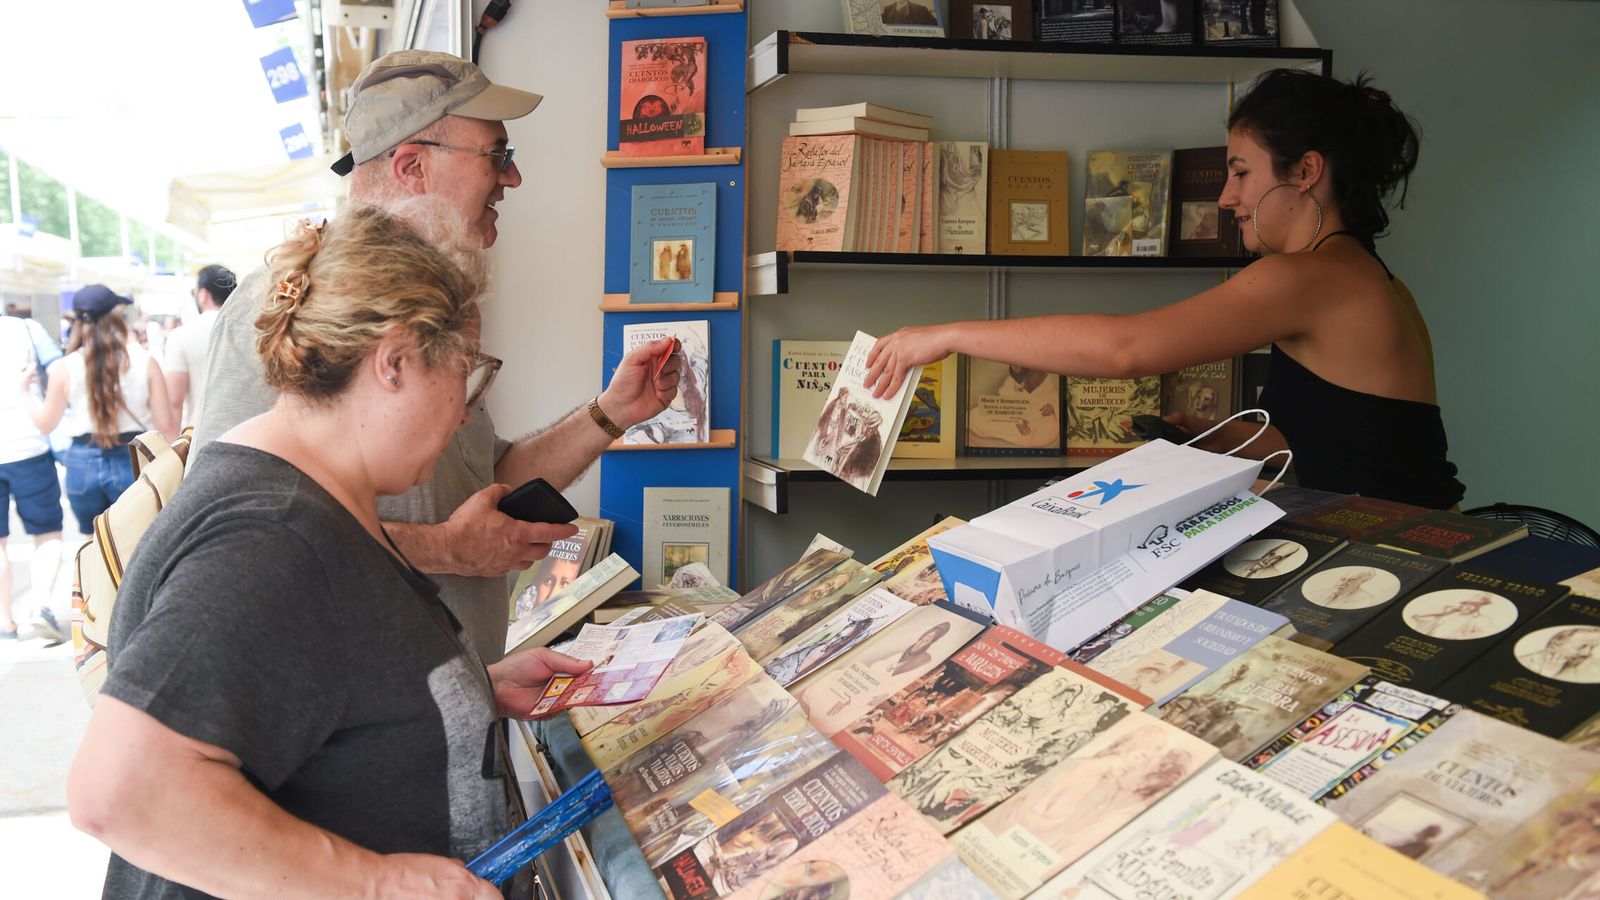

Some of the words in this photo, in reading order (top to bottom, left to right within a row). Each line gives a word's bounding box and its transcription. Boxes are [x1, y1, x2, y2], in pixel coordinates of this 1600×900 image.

[628, 69, 669, 78] CUENTOS
[626, 119, 683, 136] HALLOWEEN
[1008, 175, 1051, 184] CUENTOS
[650, 207, 697, 216] CUENTOS
[630, 333, 667, 341] CUENTOS
[1079, 398, 1127, 406] MARRUECOS
[1082, 385, 1126, 394] MUJERES
[662, 514, 710, 522] NARRACIONES
[1175, 513, 1207, 533] PARA
[1205, 497, 1242, 516] TODOS
[1183, 520, 1217, 539] PARA
[1214, 497, 1260, 522] SIEMPRE
[552, 540, 581, 552] ENTOS
[1151, 538, 1182, 558] FSC
[1456, 571, 1502, 588] FELIPE
[1503, 581, 1547, 597] TRIGO
[1213, 611, 1255, 632] TRATADOS
[1253, 623, 1269, 636] DE
[1241, 682, 1300, 713] GUERRA
[1264, 680, 1299, 696] GRAN
[979, 727, 1022, 755] MUJERES
[1306, 723, 1393, 753] ASESINA
[664, 753, 685, 776] VIAJES
[672, 741, 701, 773] CUENTOS
[957, 739, 1001, 770] MARRUECOS
[650, 758, 675, 787] VIAJEROS
[1436, 760, 1517, 797] CUENTOS
[803, 778, 848, 822] CUENTOS
[1216, 768, 1261, 798] EDGAR
[1254, 782, 1315, 825] NEVILLE
